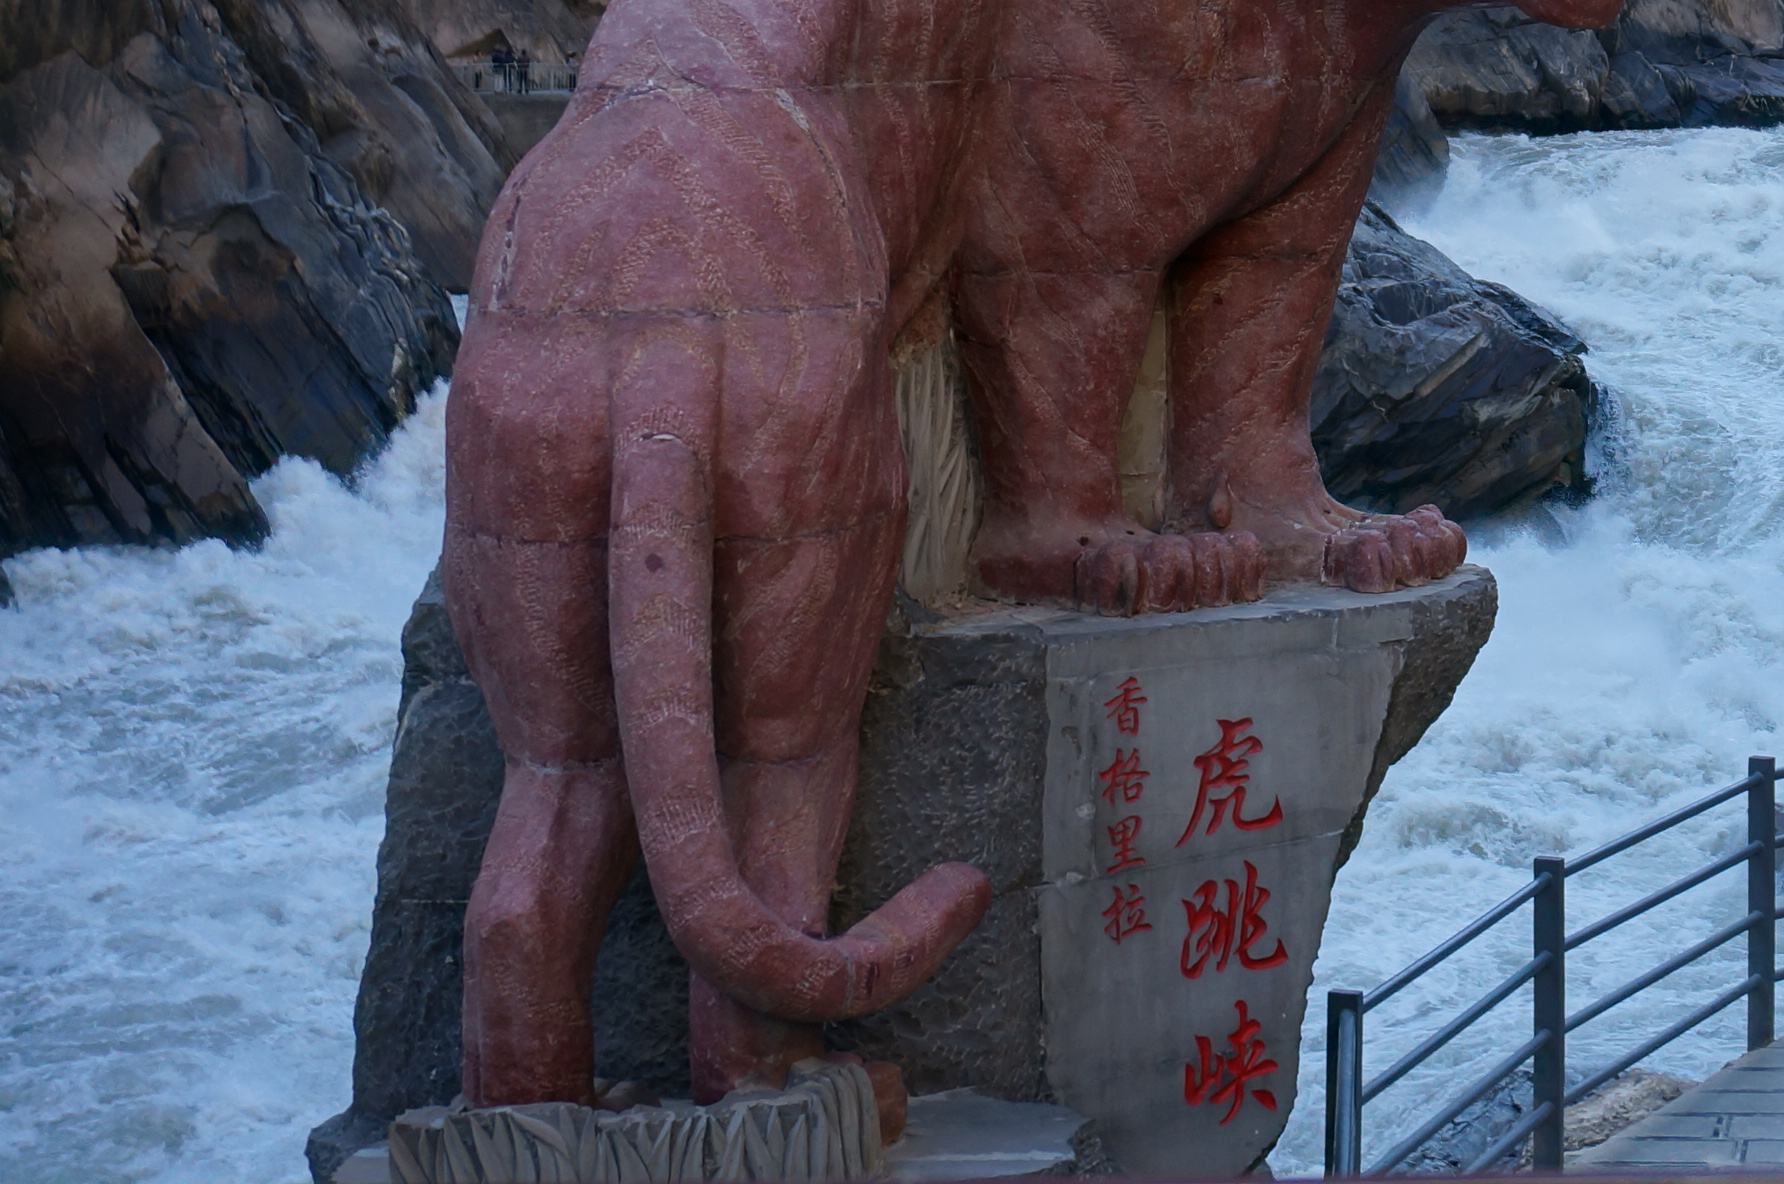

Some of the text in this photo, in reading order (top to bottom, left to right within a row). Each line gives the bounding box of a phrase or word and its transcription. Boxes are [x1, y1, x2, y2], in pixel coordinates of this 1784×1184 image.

[1099, 676, 1153, 945] 香格里拉
[1175, 718, 1289, 1126] 虎跳峡
